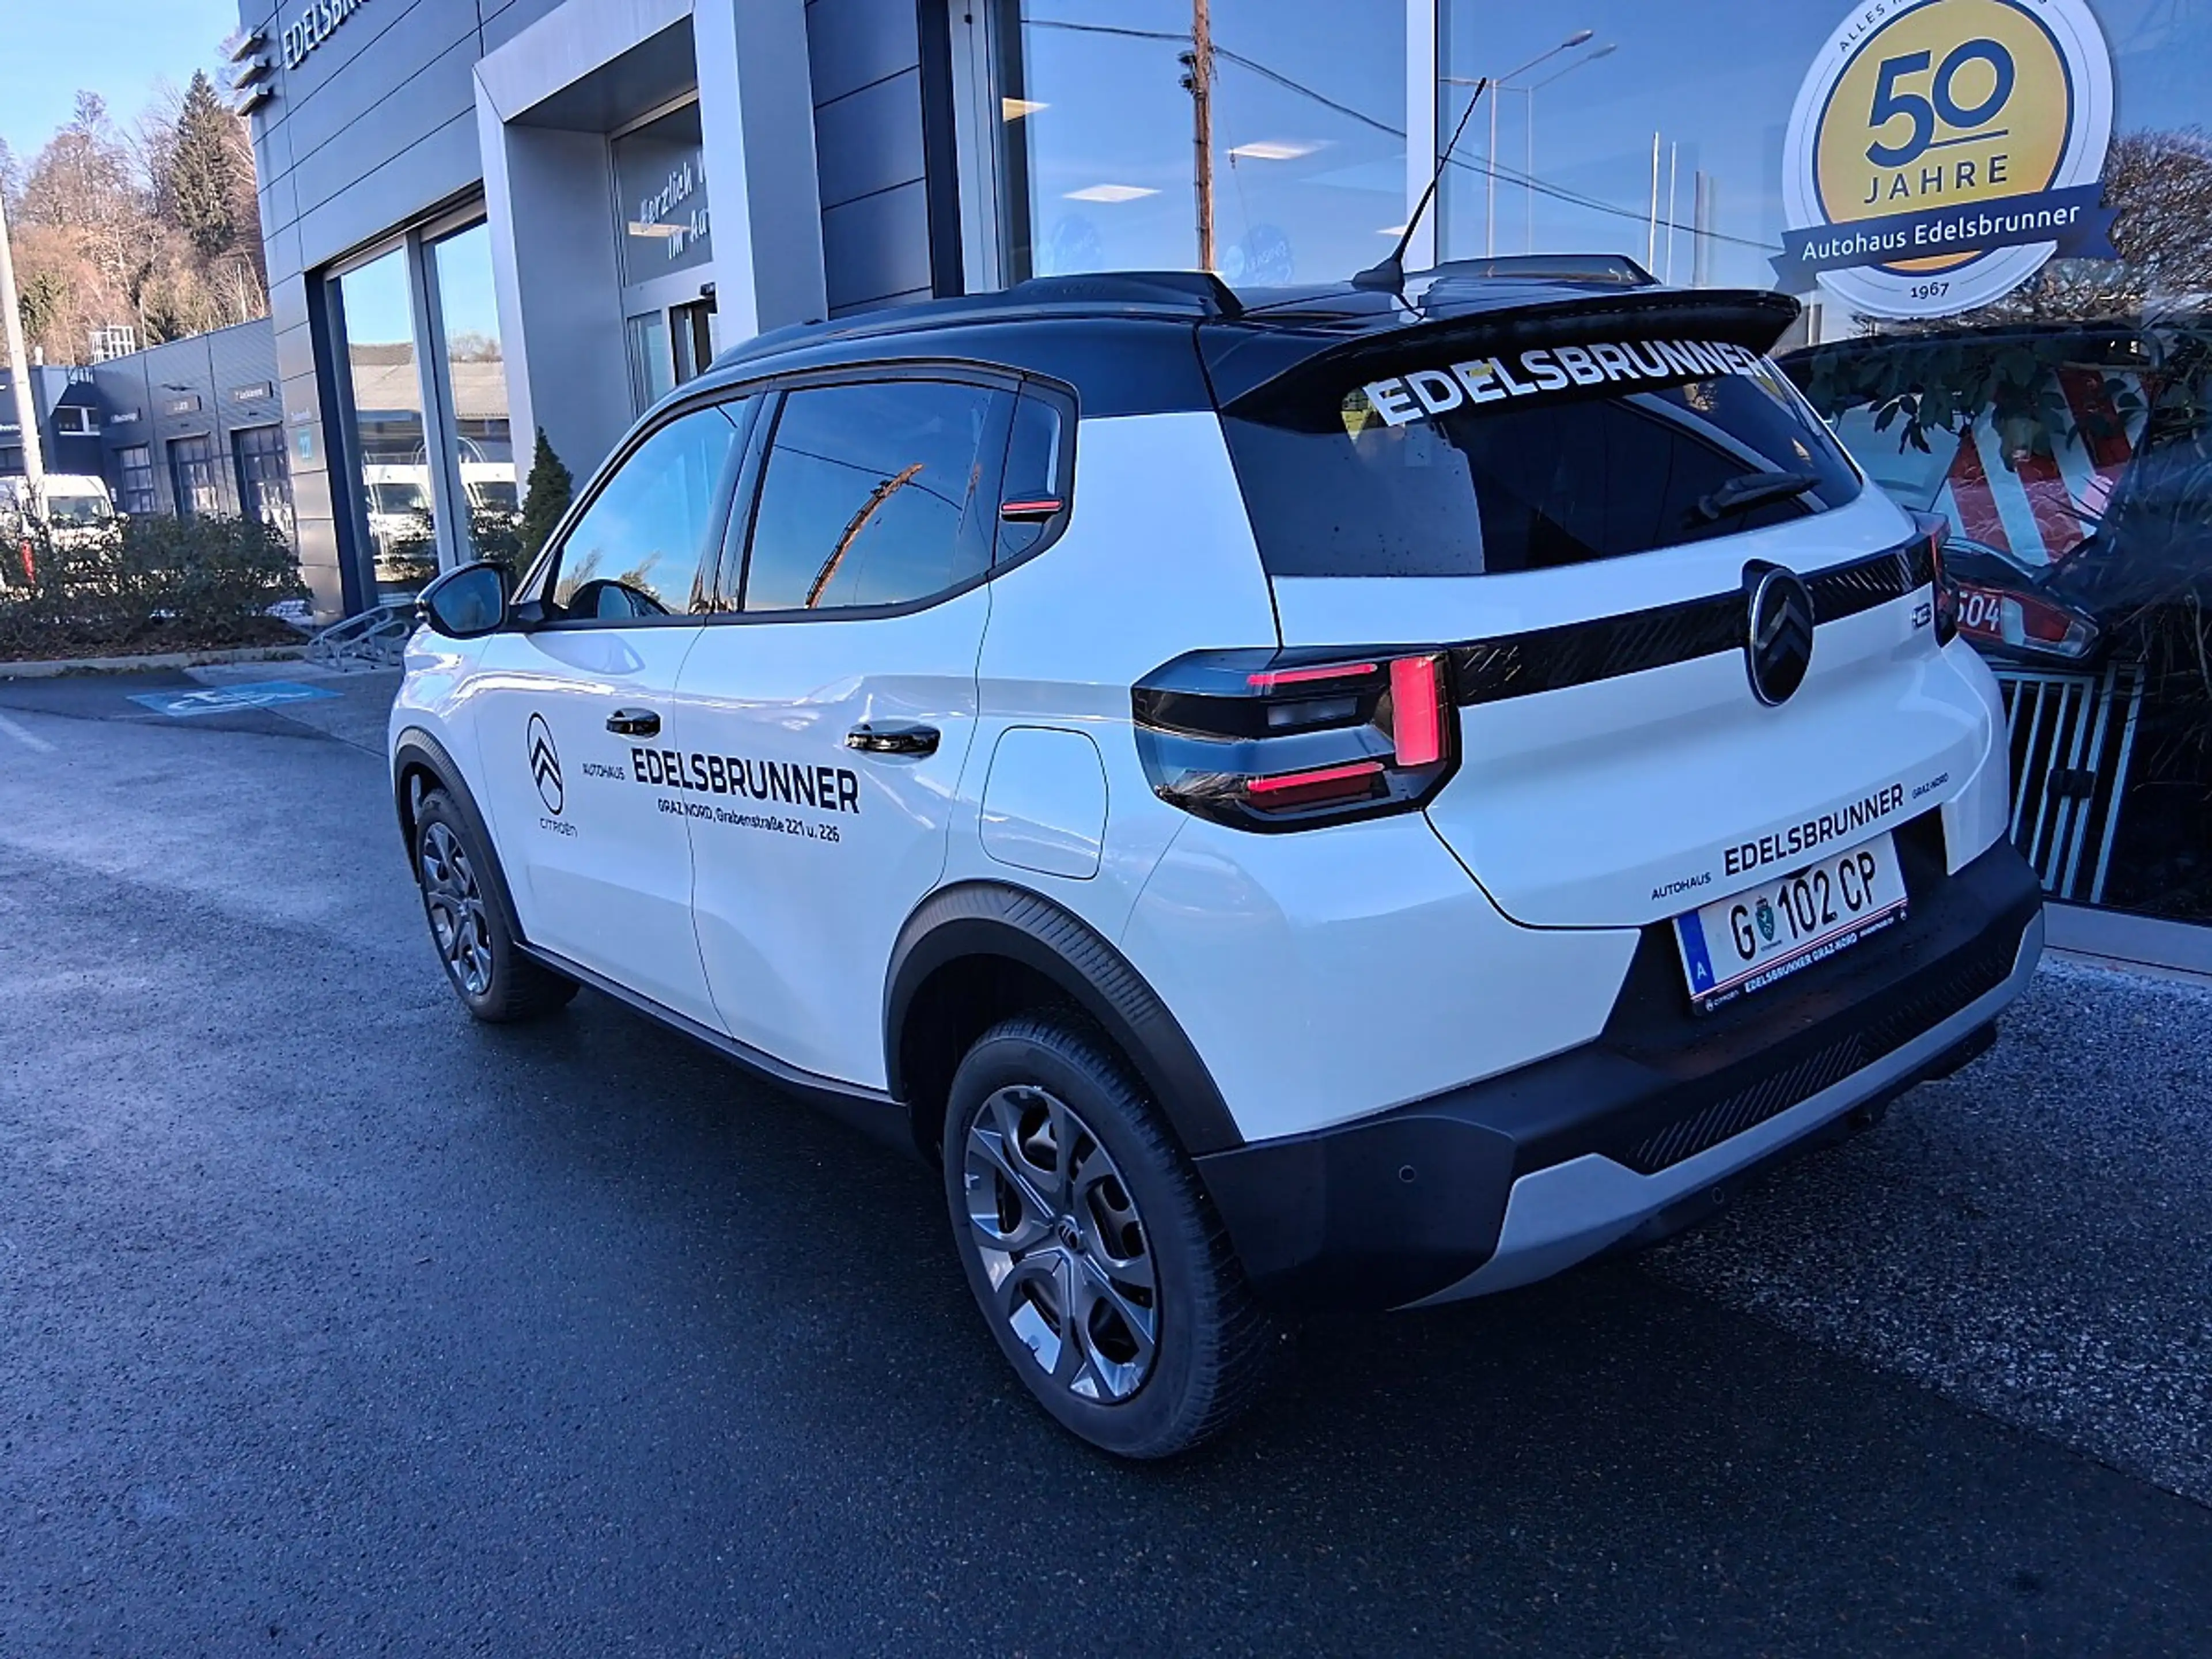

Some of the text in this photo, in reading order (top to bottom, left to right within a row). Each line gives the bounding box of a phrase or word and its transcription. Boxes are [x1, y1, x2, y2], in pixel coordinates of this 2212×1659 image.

[1839, 3, 1887, 52] ALLES
[1865, 37, 2016, 168] 50
[1864, 154, 2009, 204] JAHRE
[1802, 203, 2081, 261] Autohaus Edelsbrunner
[1910, 282, 1949, 299] 1967
[1363, 340, 1773, 426] EDELSBRUNNER
[631, 748, 859, 813] EDELSBRUNNER
[716, 807, 785, 833] Grabenstraße
[786, 818, 805, 836] 221
[806, 825, 817, 838] u.
[819, 824, 840, 842] 226
[1652, 872, 1711, 900] AUTOHAUS
[1724, 783, 1903, 877] EDELSBRUNNER
[1730, 851, 1876, 961] G 102 CP
[1697, 960, 1707, 979] A
